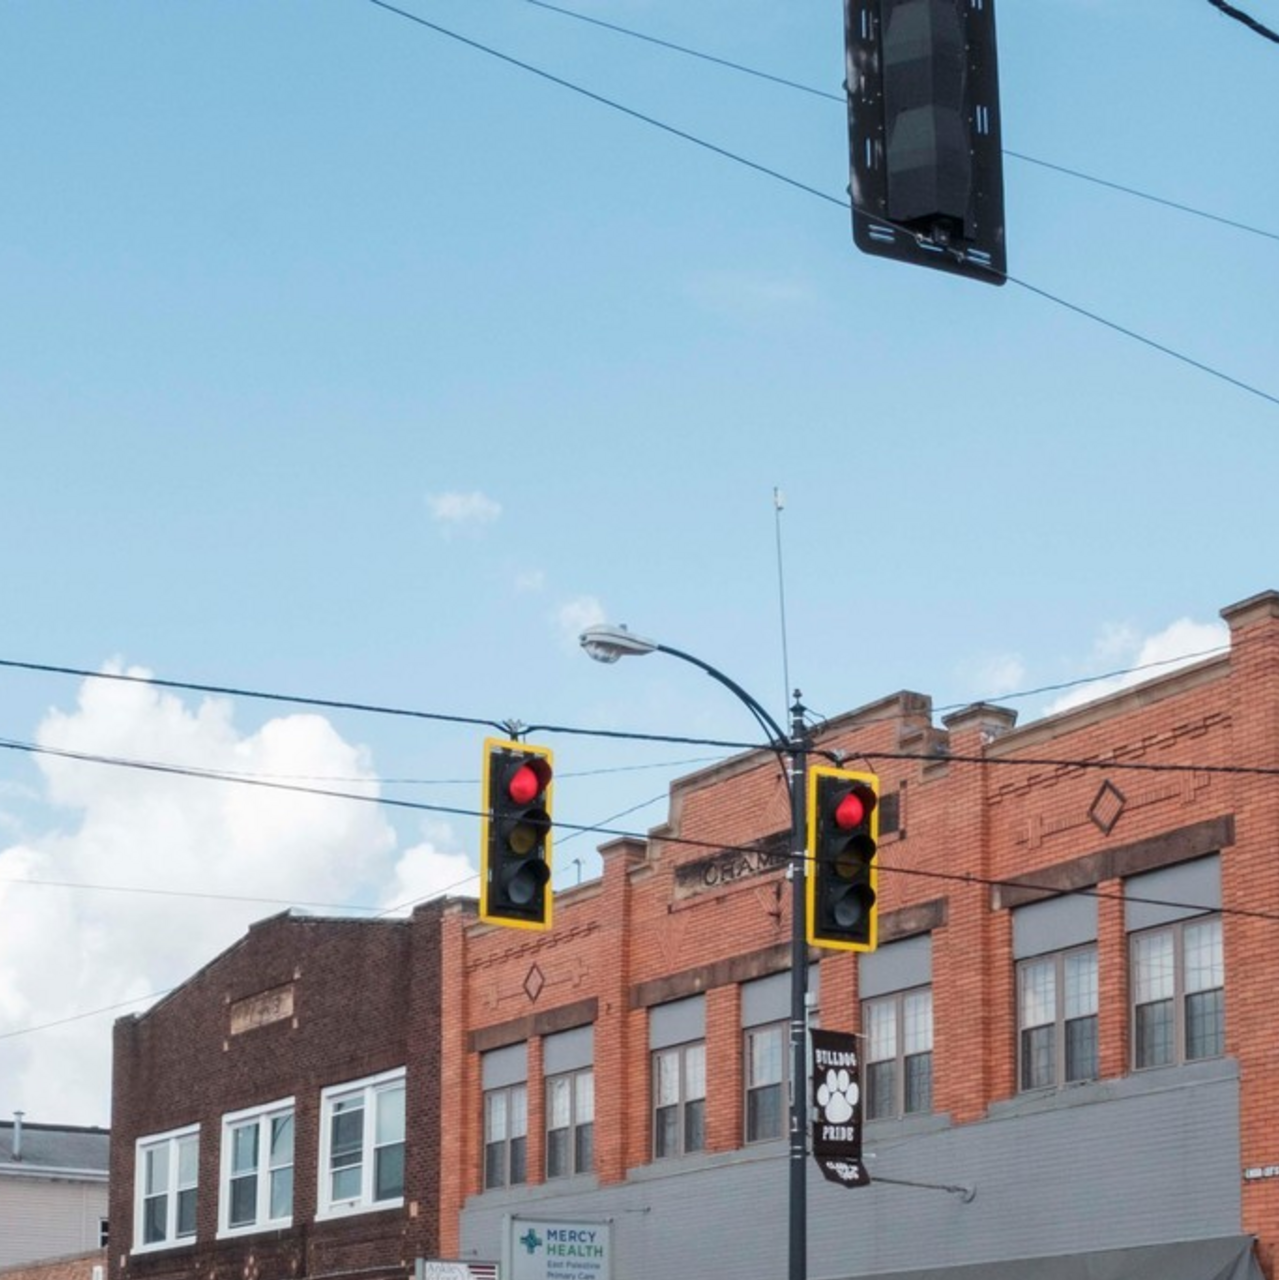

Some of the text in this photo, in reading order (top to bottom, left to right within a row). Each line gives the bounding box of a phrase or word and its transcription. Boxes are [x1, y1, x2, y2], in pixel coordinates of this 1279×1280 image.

[815, 1048, 858, 1067] BULLDOG
[822, 1125, 855, 1141] PRIDE
[546, 1229, 597, 1243] MERCY
[546, 1244, 604, 1257] HEALTH
[547, 1260, 601, 1270] East Palestine
[547, 1271, 596, 1280] Primary Care
